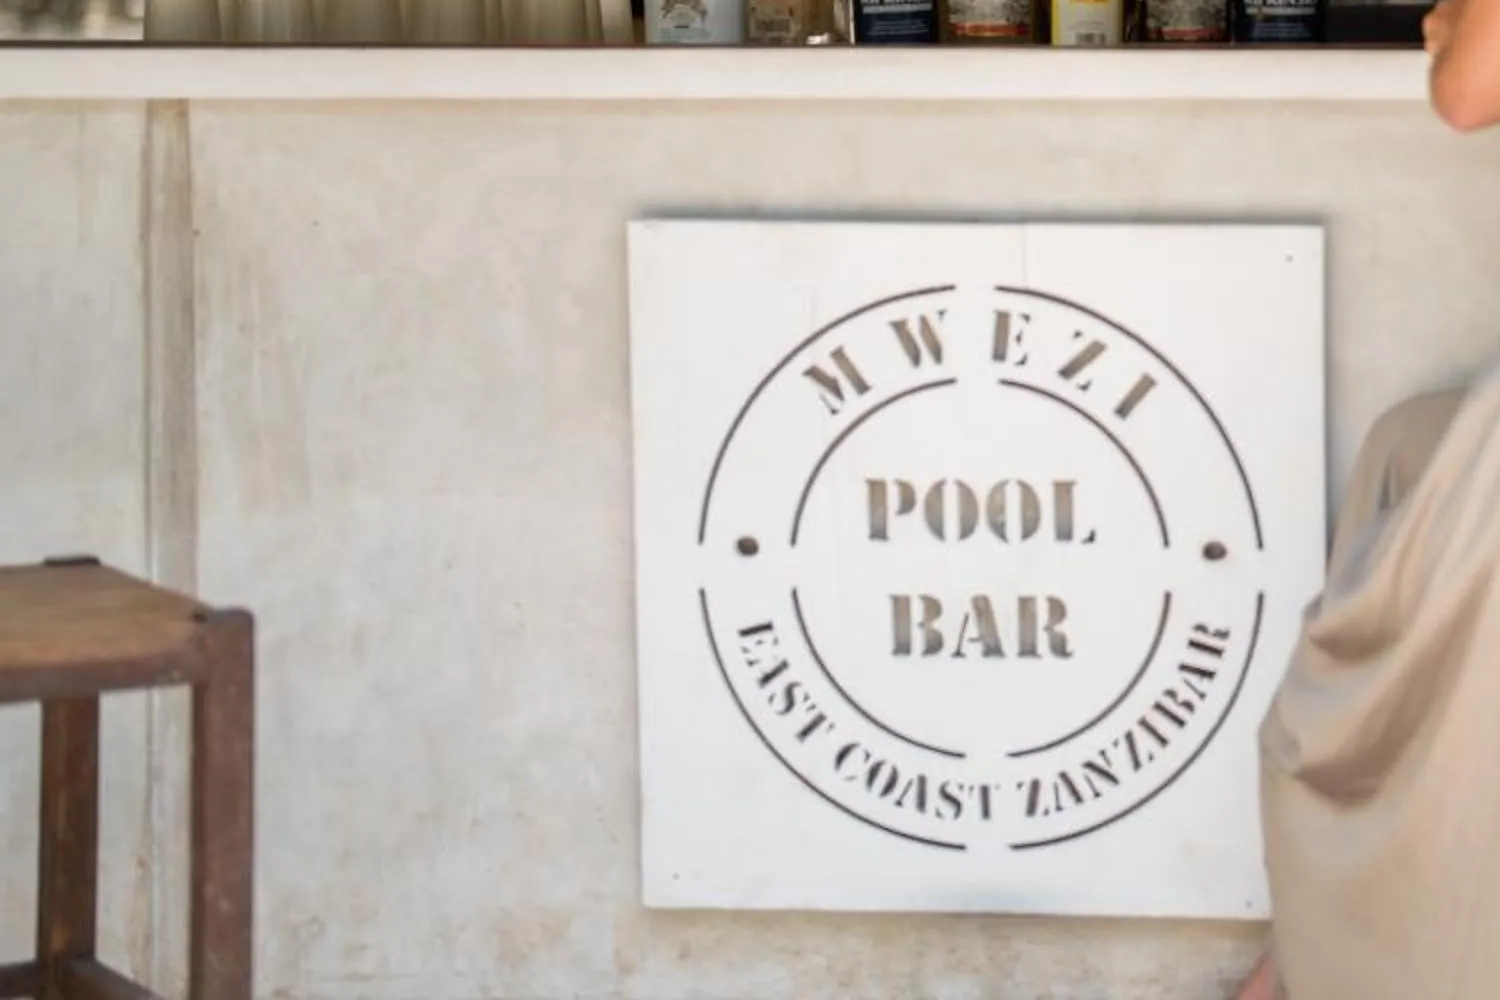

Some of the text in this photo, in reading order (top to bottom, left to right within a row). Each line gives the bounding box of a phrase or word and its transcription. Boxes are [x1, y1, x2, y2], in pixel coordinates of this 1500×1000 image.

[802, 308, 1158, 420] MWEZI
[865, 478, 1096, 545] POOL
[888, 593, 1076, 660] BAR
[736, 620, 1232, 823] EAST COAST ZANZIBAR
